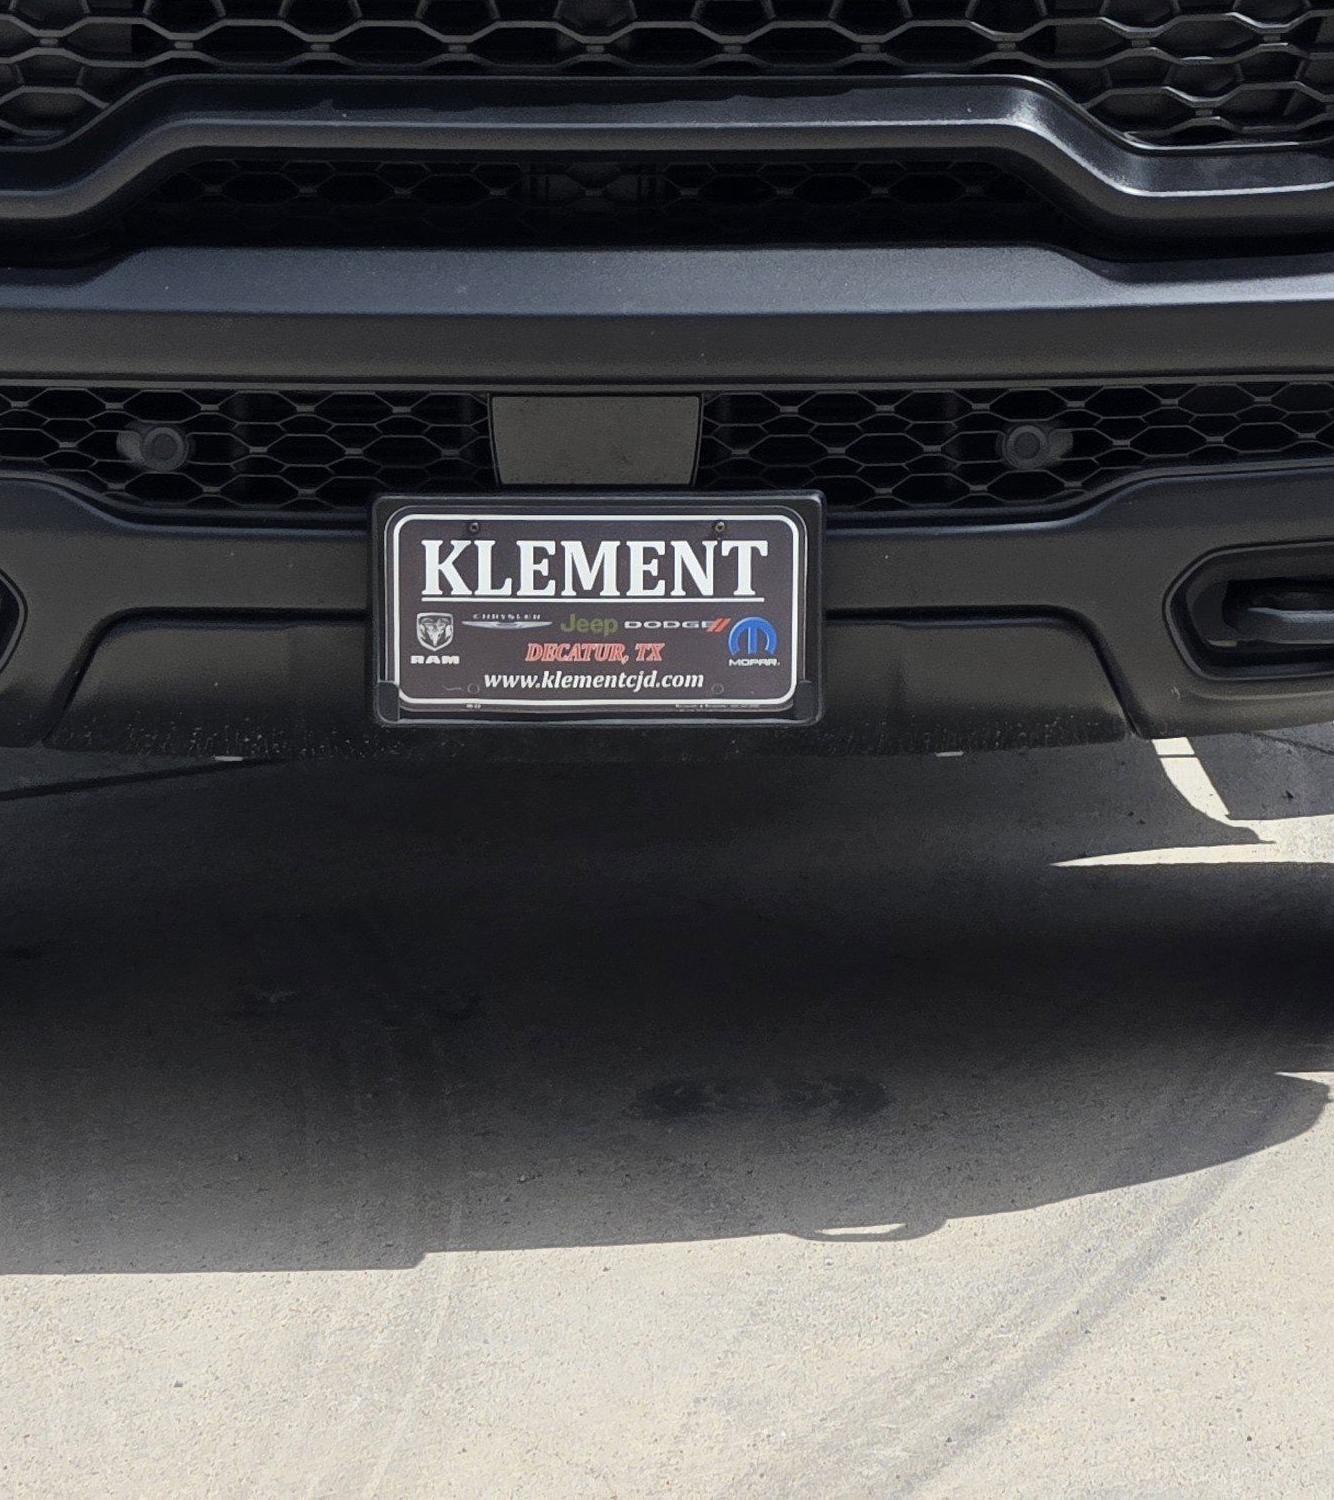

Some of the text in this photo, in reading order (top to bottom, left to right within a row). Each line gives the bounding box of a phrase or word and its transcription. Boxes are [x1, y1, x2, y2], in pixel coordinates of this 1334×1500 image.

[421, 539, 768, 597] KLEMENT
[560, 613, 618, 637] Jeep
[624, 620, 714, 629] DODGE
[410, 655, 460, 665] RAM
[525, 643, 665, 665] DECATUR, TX
[484, 670, 704, 693] www.klementcjd.com
